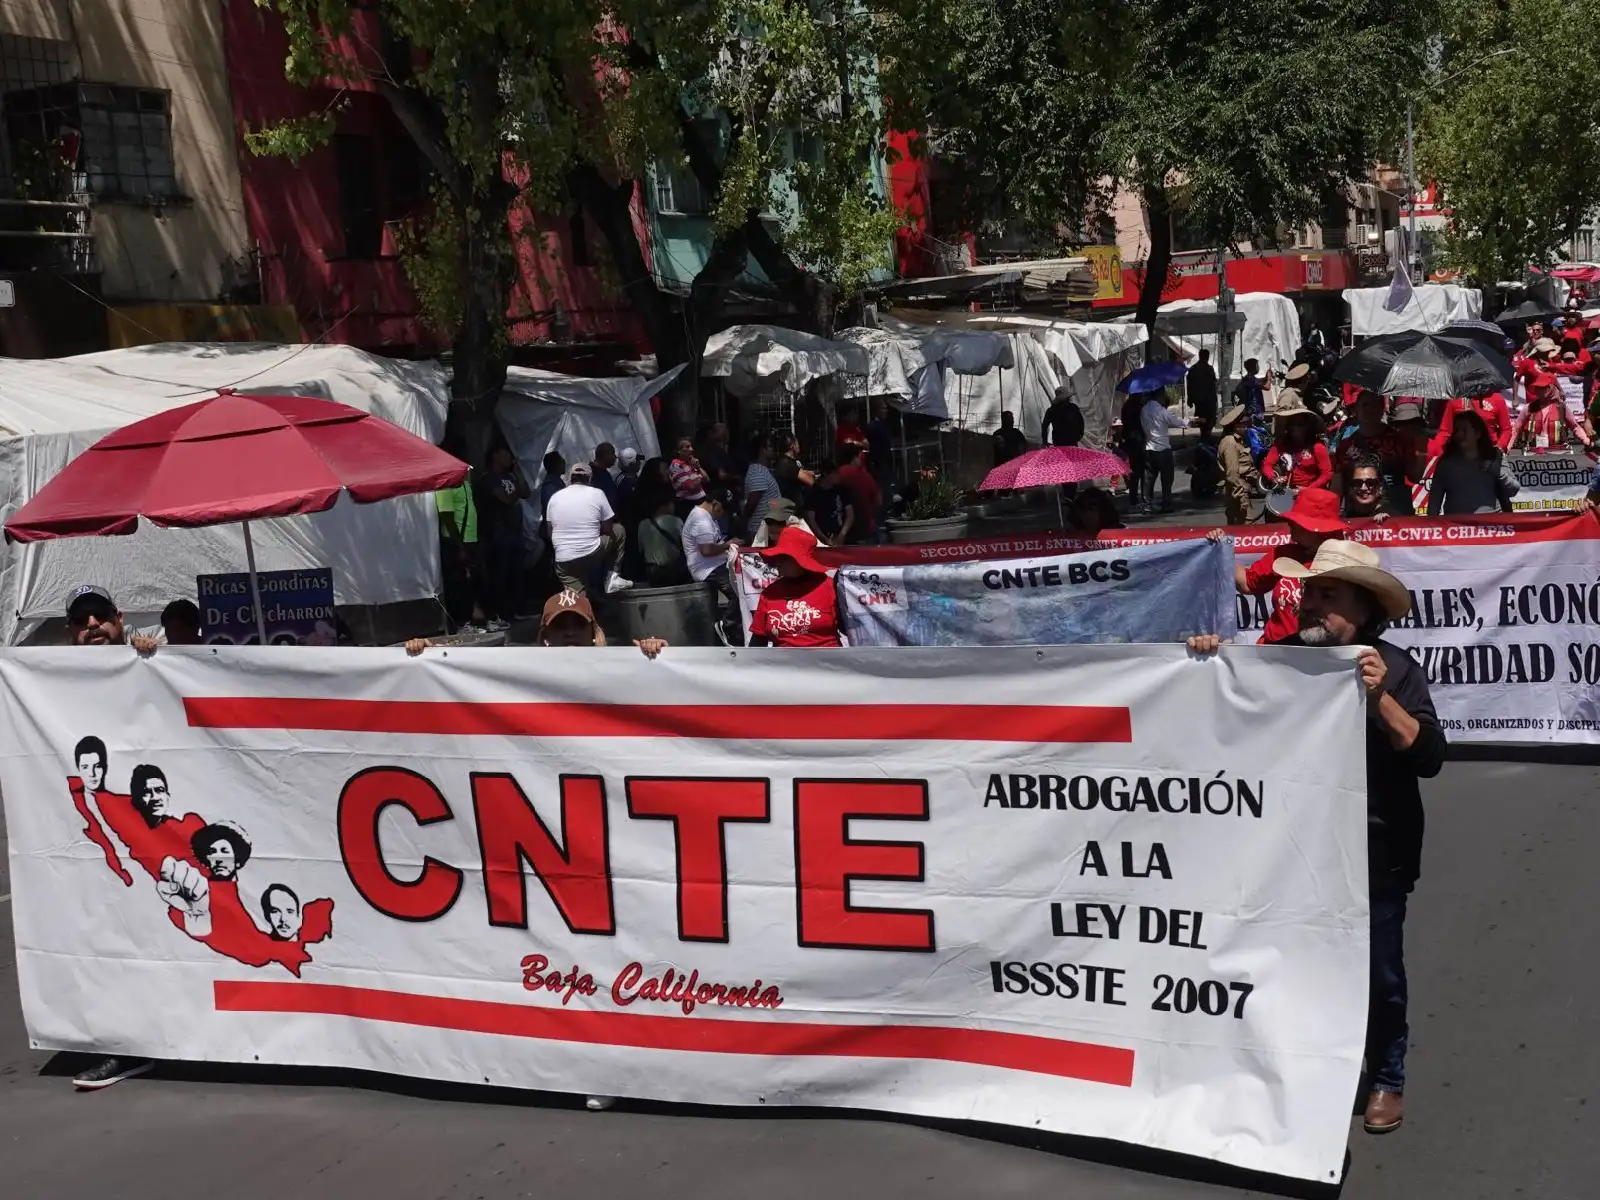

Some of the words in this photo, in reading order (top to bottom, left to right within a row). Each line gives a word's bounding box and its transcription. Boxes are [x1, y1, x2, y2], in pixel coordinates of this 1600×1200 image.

[1516, 459, 1577, 472] Primaria
[1521, 471, 1539, 487] de
[921, 544, 987, 559] SECCIÓN
[1014, 540, 1043, 552] DEL
[1234, 531, 1292, 547] ECCIÓN
[1355, 527, 1443, 542] SNTE-CNTE
[1446, 525, 1515, 539] CHIAPAS
[982, 565, 1062, 590] CNTE
[1068, 559, 1130, 585] BCS
[1389, 587, 1484, 632] ALES,
[1467, 718, 1544, 729] ORGANIZADOS
[1546, 719, 1554, 729] Y
[983, 770, 1263, 818] ABROGACIÓN
[337, 765, 935, 953] CNTE
[1079, 840, 1108, 876] A
[1121, 841, 1173, 879] LA
[1050, 902, 1126, 939] LEY
[1139, 906, 1207, 950] DEL
[520, 954, 598, 1007] Baja
[611, 961, 784, 1015] California
[990, 961, 1126, 1006] ISSSTE
[1151, 974, 1254, 1019] 2007
